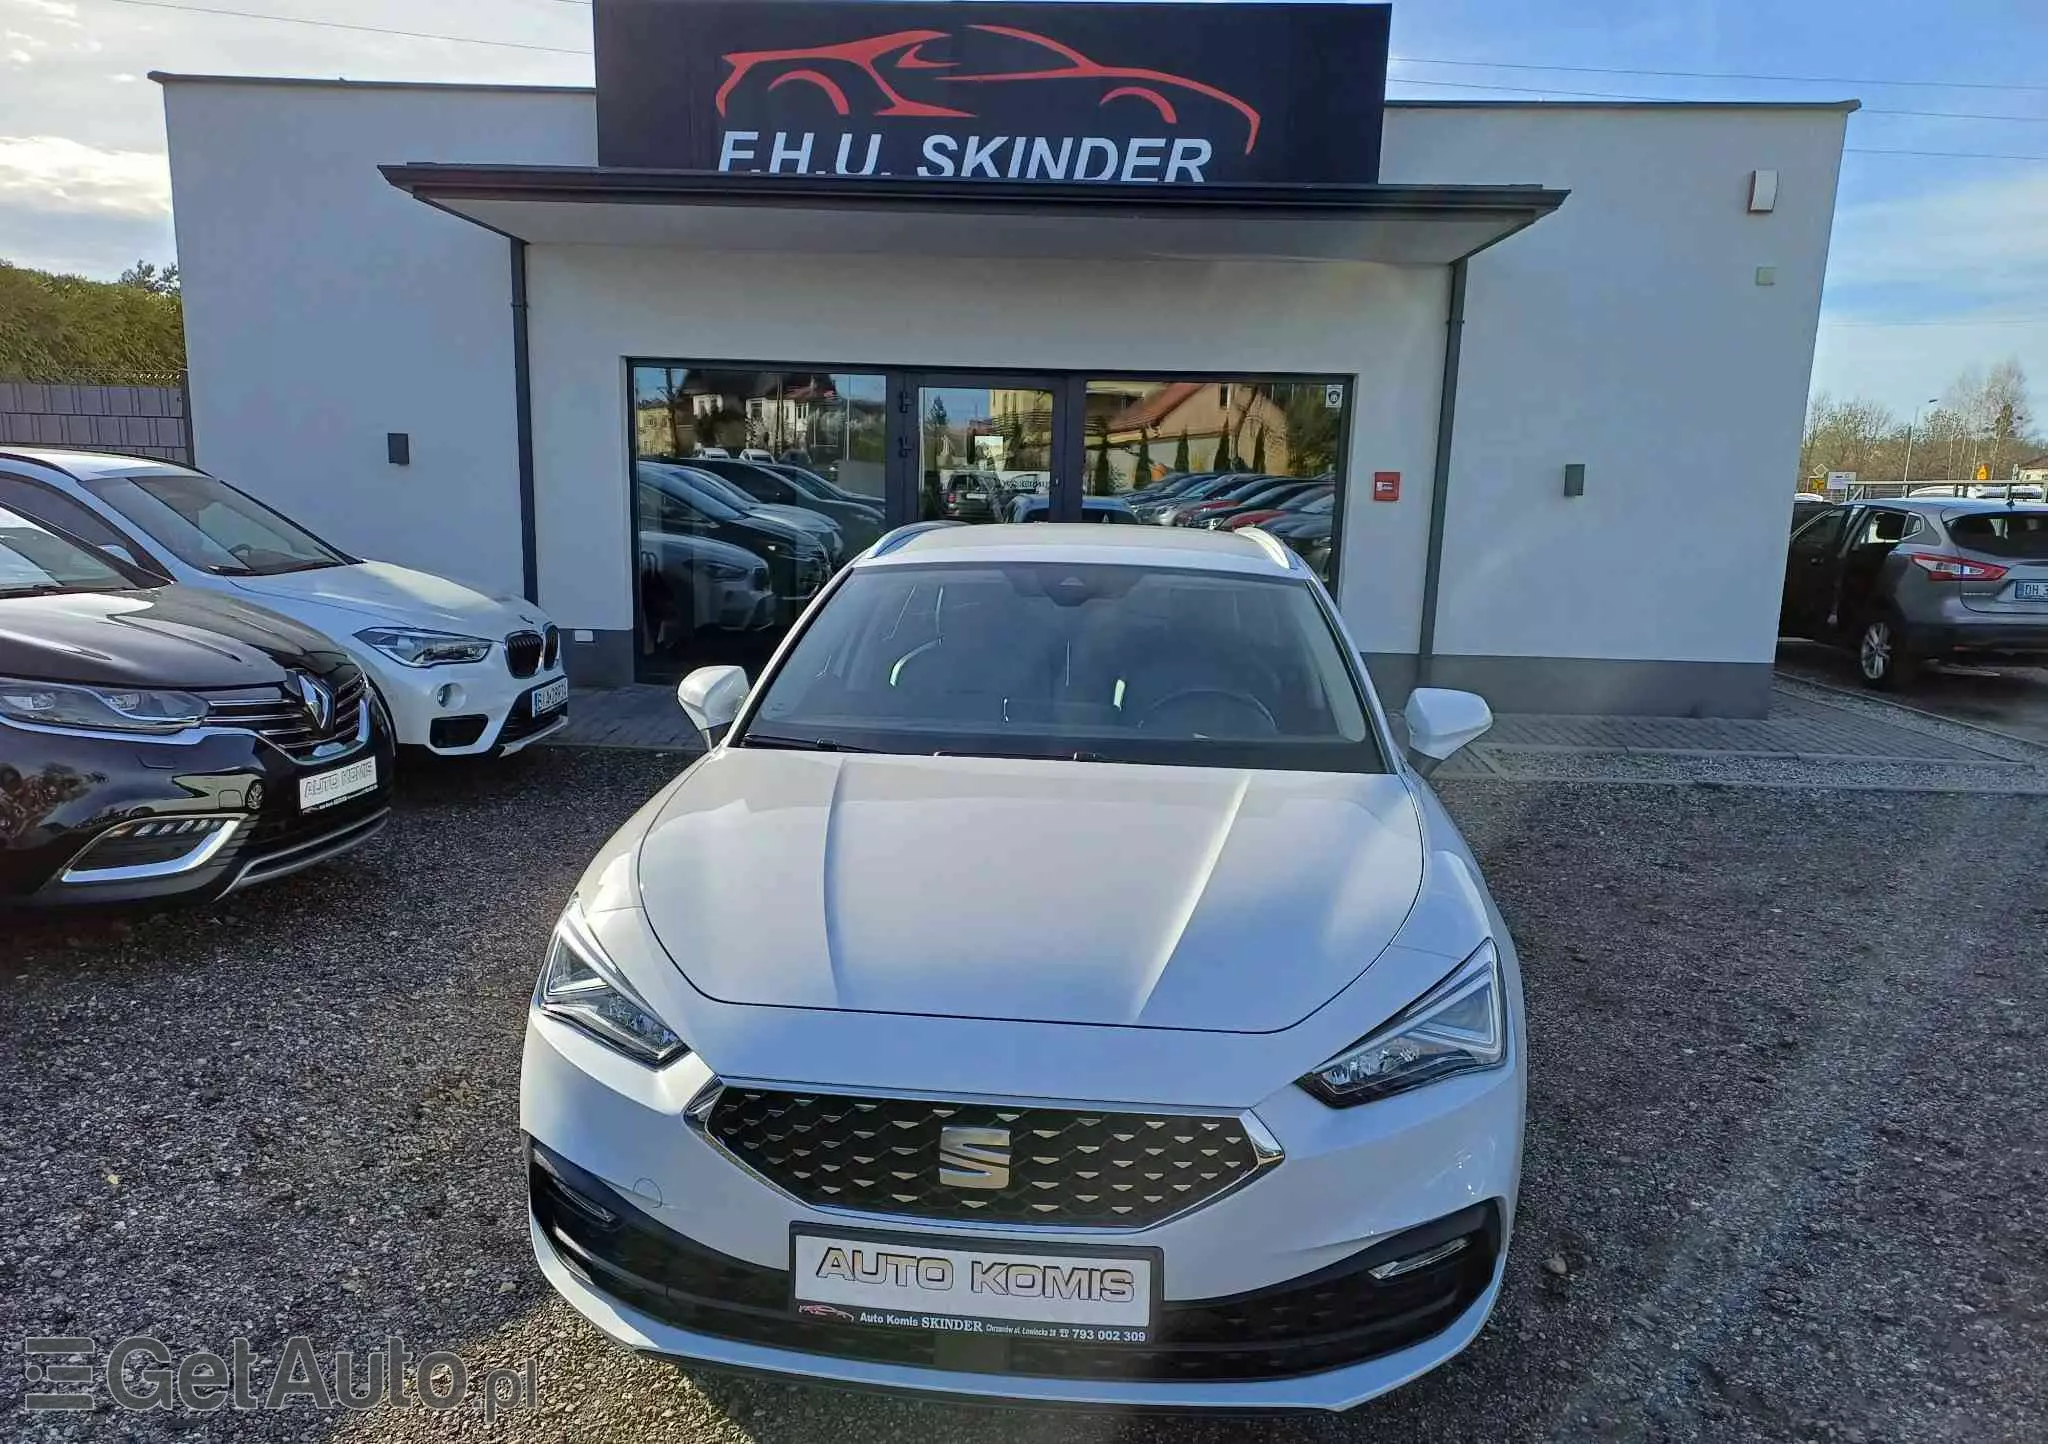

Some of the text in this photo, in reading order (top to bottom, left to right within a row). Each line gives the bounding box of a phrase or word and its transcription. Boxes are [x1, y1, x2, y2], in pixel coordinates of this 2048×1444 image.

[718, 131, 1214, 183] F.H.U. SKINDER
[816, 1246, 1135, 1304] AUTO KOMIS
[859, 1312, 884, 1324] Auto
[886, 1314, 919, 1327] Komis
[921, 1316, 984, 1333] SKINDER
[1072, 1328, 1095, 1340] 793
[1097, 1330, 1120, 1341] 002
[1122, 1331, 1146, 1342] 309
